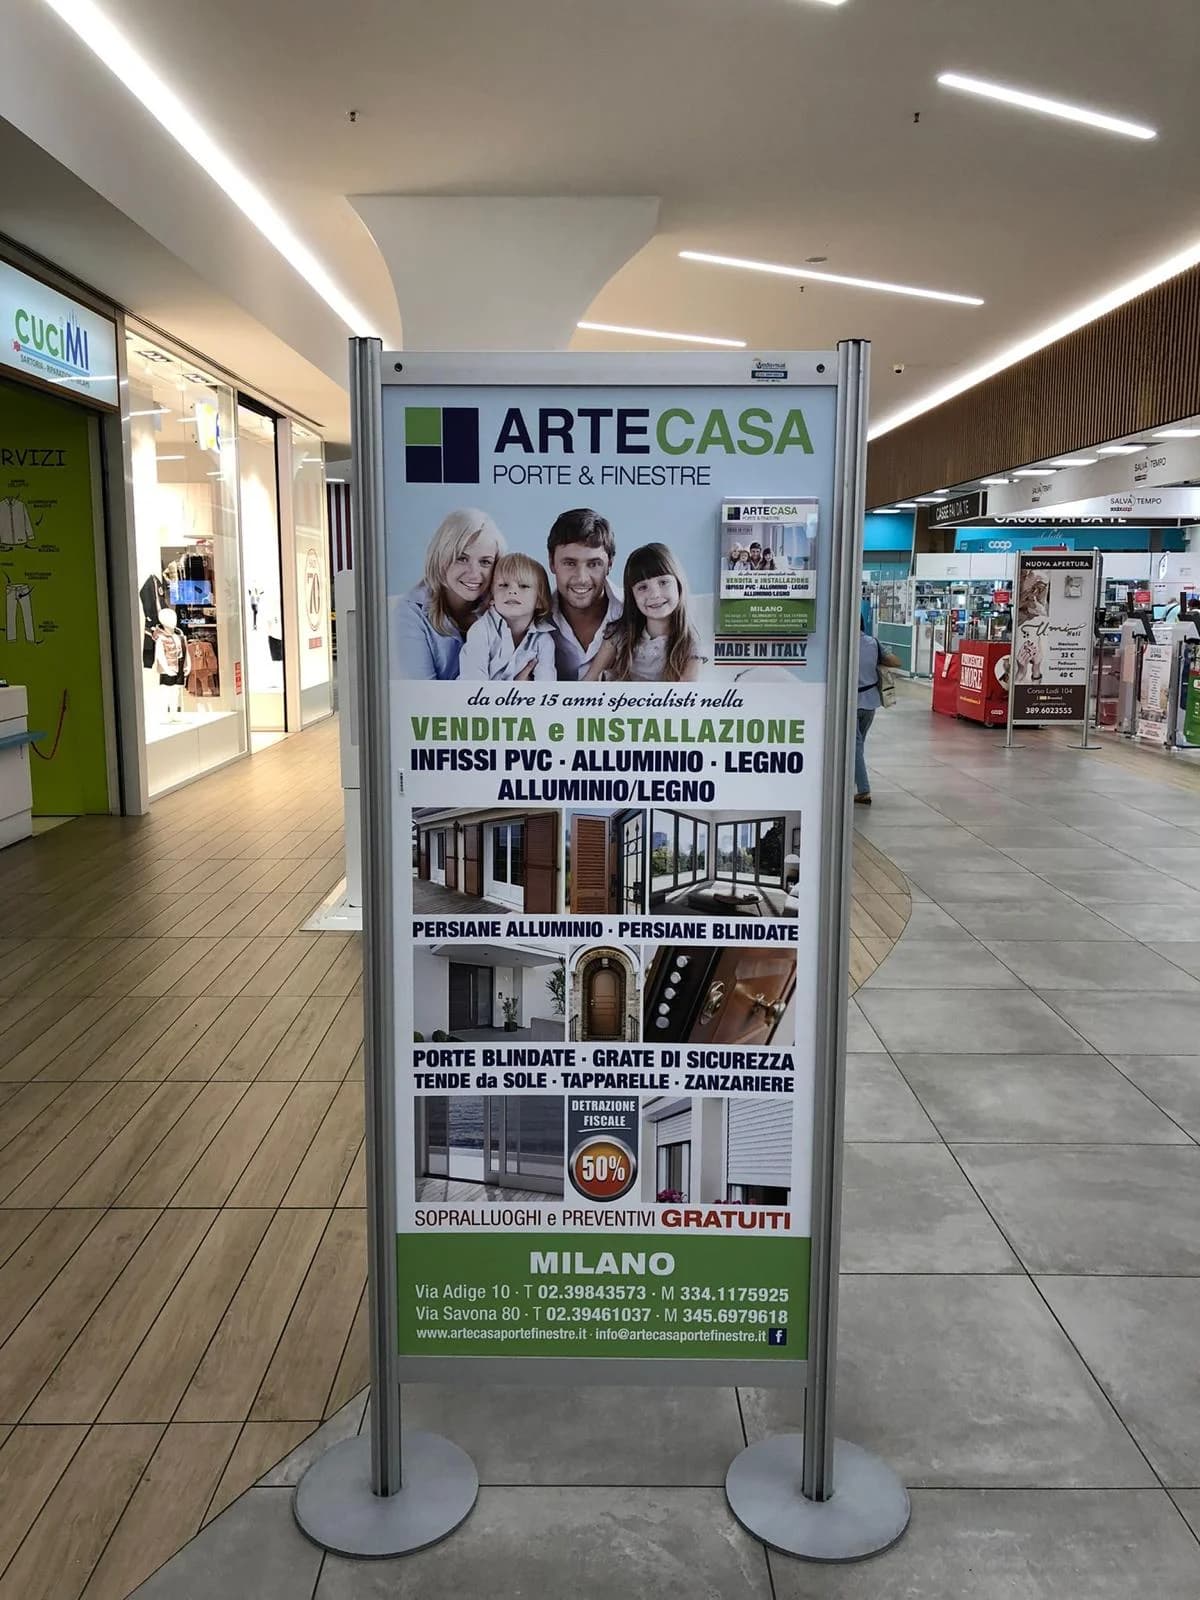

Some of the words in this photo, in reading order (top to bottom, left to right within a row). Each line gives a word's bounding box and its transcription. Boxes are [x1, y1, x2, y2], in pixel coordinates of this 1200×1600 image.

[494, 408, 814, 455] ARTECASA
[1134, 462, 1148, 472] SALVA
[1150, 458, 1166, 468] TEMPO
[494, 466, 571, 485] PORTE
[578, 466, 594, 486] &
[601, 466, 711, 486] FINESTRE
[936, 504, 949, 520] CASSE
[988, 540, 1012, 549] coop
[714, 642, 750, 657] MADE
[754, 642, 767, 657] IN
[772, 642, 808, 658] ITALY
[467, 688, 490, 706] da
[494, 688, 536, 706] oltre
[541, 692, 558, 706] 15
[562, 692, 603, 707] anni
[608, 690, 696, 712] specialisti
[701, 690, 743, 708] nella
[411, 716, 536, 742] VENDITA
[548, 724, 564, 742] e
[577, 718, 805, 744] INSTALLAZIONE
[411, 749, 496, 771] INFISSI
[505, 750, 552, 771] PVC
[572, 750, 703, 772] ALLUMINIO
[724, 751, 803, 774] LEGNO
[498, 779, 715, 802] ALLUMINIO/LEGNO
[412, 921, 501, 938] PERSIANE
[506, 921, 604, 938] ALLUMINIO
[618, 922, 707, 939] PERSIANE
[712, 923, 799, 941] BLINDATE
[413, 1050, 476, 1067] PORTE
[482, 1050, 576, 1067] BLINDATE
[592, 1051, 656, 1068] GRATE
[661, 1051, 680, 1068] DI
[687, 1051, 795, 1071] SICUREZZA
[414, 1073, 472, 1089] TENDE
[476, 1072, 498, 1088] da
[503, 1072, 547, 1088] SOLE
[561, 1073, 670, 1090] TAPPARELLE
[685, 1074, 795, 1092] ZANZARIERE
[572, 1100, 636, 1112] DETRAZIONE
[583, 1115, 626, 1127] FISCALE
[582, 1155, 626, 1182] 50%
[415, 1209, 542, 1227] SOPRALLUOGHI
[547, 1214, 556, 1227] e
[563, 1210, 656, 1227] PREVENTIVI
[661, 1210, 791, 1230] GRATUITI
[529, 1252, 676, 1276] MILANO
[416, 1285, 438, 1299] Via
[442, 1285, 486, 1302] Adige
[492, 1285, 510, 1299] 10
[523, 1285, 532, 1299] T
[538, 1285, 646, 1300] 02.39843573
[661, 1287, 675, 1300] M
[680, 1286, 789, 1302] 334.1175925
[416, 1306, 438, 1321] Via
[443, 1306, 498, 1321] Savona
[502, 1307, 520, 1321] 80
[533, 1307, 541, 1321] T
[546, 1307, 651, 1322] 02.39461037
[664, 1309, 677, 1322] M
[683, 1308, 788, 1324] 345.6979618
[416, 1327, 587, 1341] www.artecasaportefinestre.it
[595, 1328, 766, 1344] info@artecasaportefinestre.it
